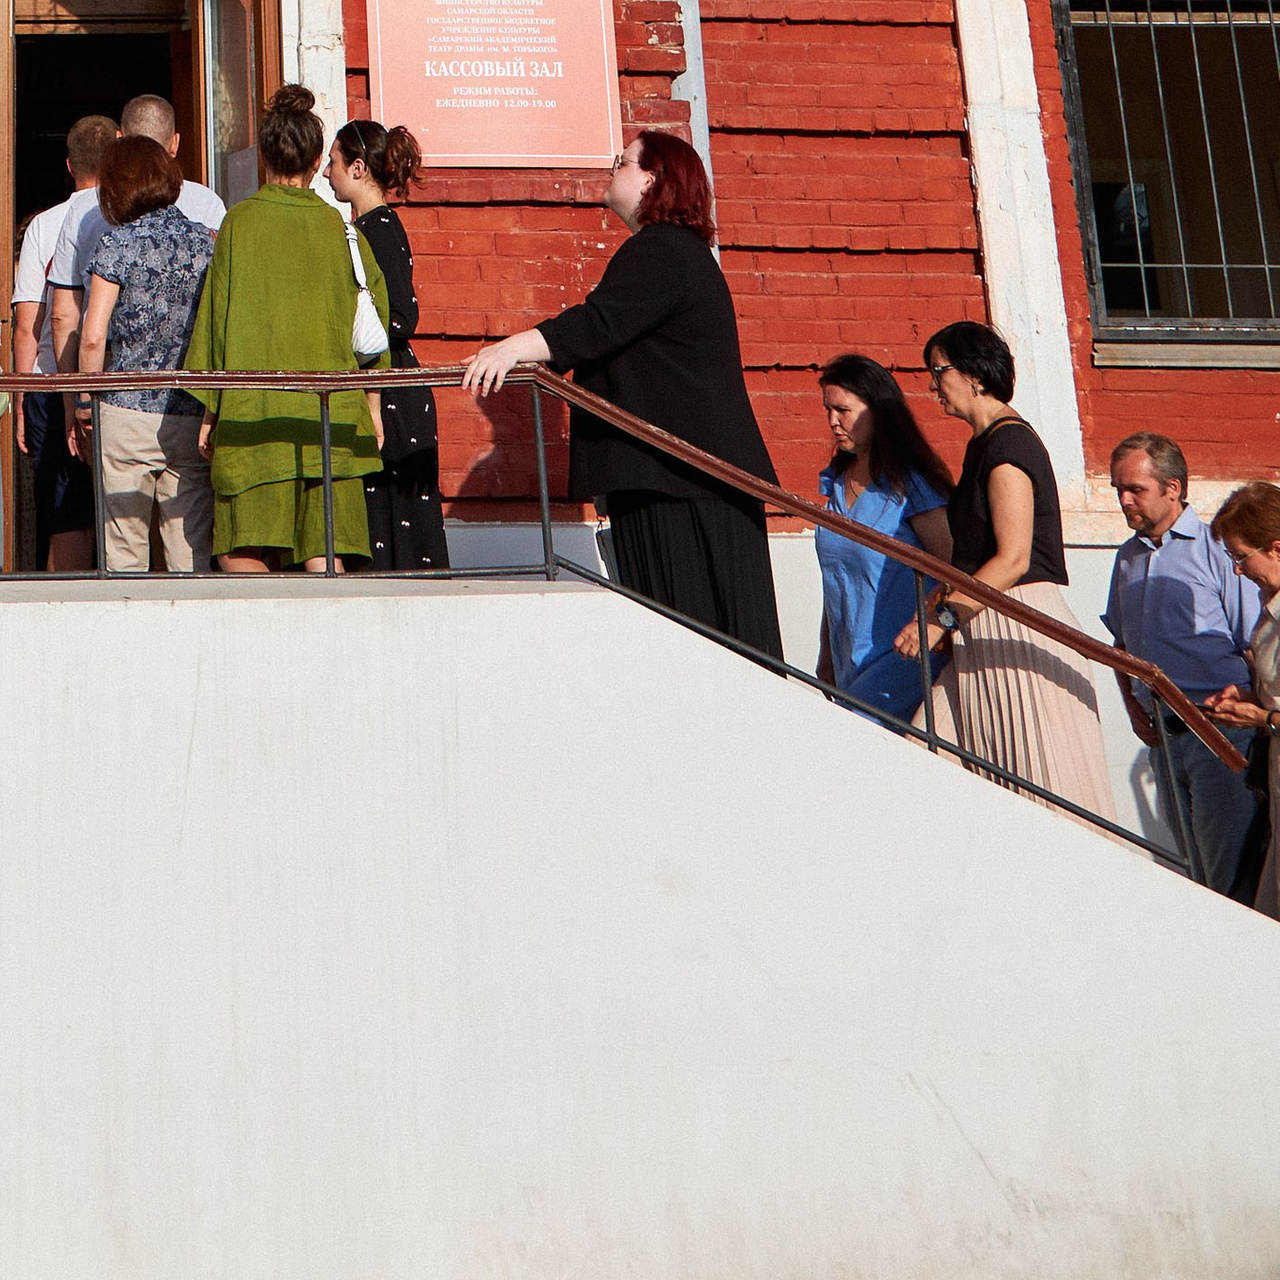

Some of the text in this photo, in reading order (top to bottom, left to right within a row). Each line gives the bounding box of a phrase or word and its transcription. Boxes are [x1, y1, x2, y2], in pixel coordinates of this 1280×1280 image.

[446, 7, 495, 15] САМАРСКОЙ
[426, 17, 556, 26] ГОСУДАРСТВЕННОЕ БЮДЖЕТНОЕ
[441, 26, 541, 34] УЧРЕЖДЕНИЕ КУЛЬТУРЫ
[484, 36, 557, 44] АКАДЕМИЧЕСКИЙ
[428, 45, 452, 53] ТЕАТР
[454, 45, 484, 53] ДРАМЫ
[424, 56, 564, 78] КАССОВЫЙ ЗАЛ
[453, 87, 538, 96] РЕЖИМ РАБОТЫ:
[435, 98, 557, 108] ЕЖЕДНЕВНО 12.00-19.00
